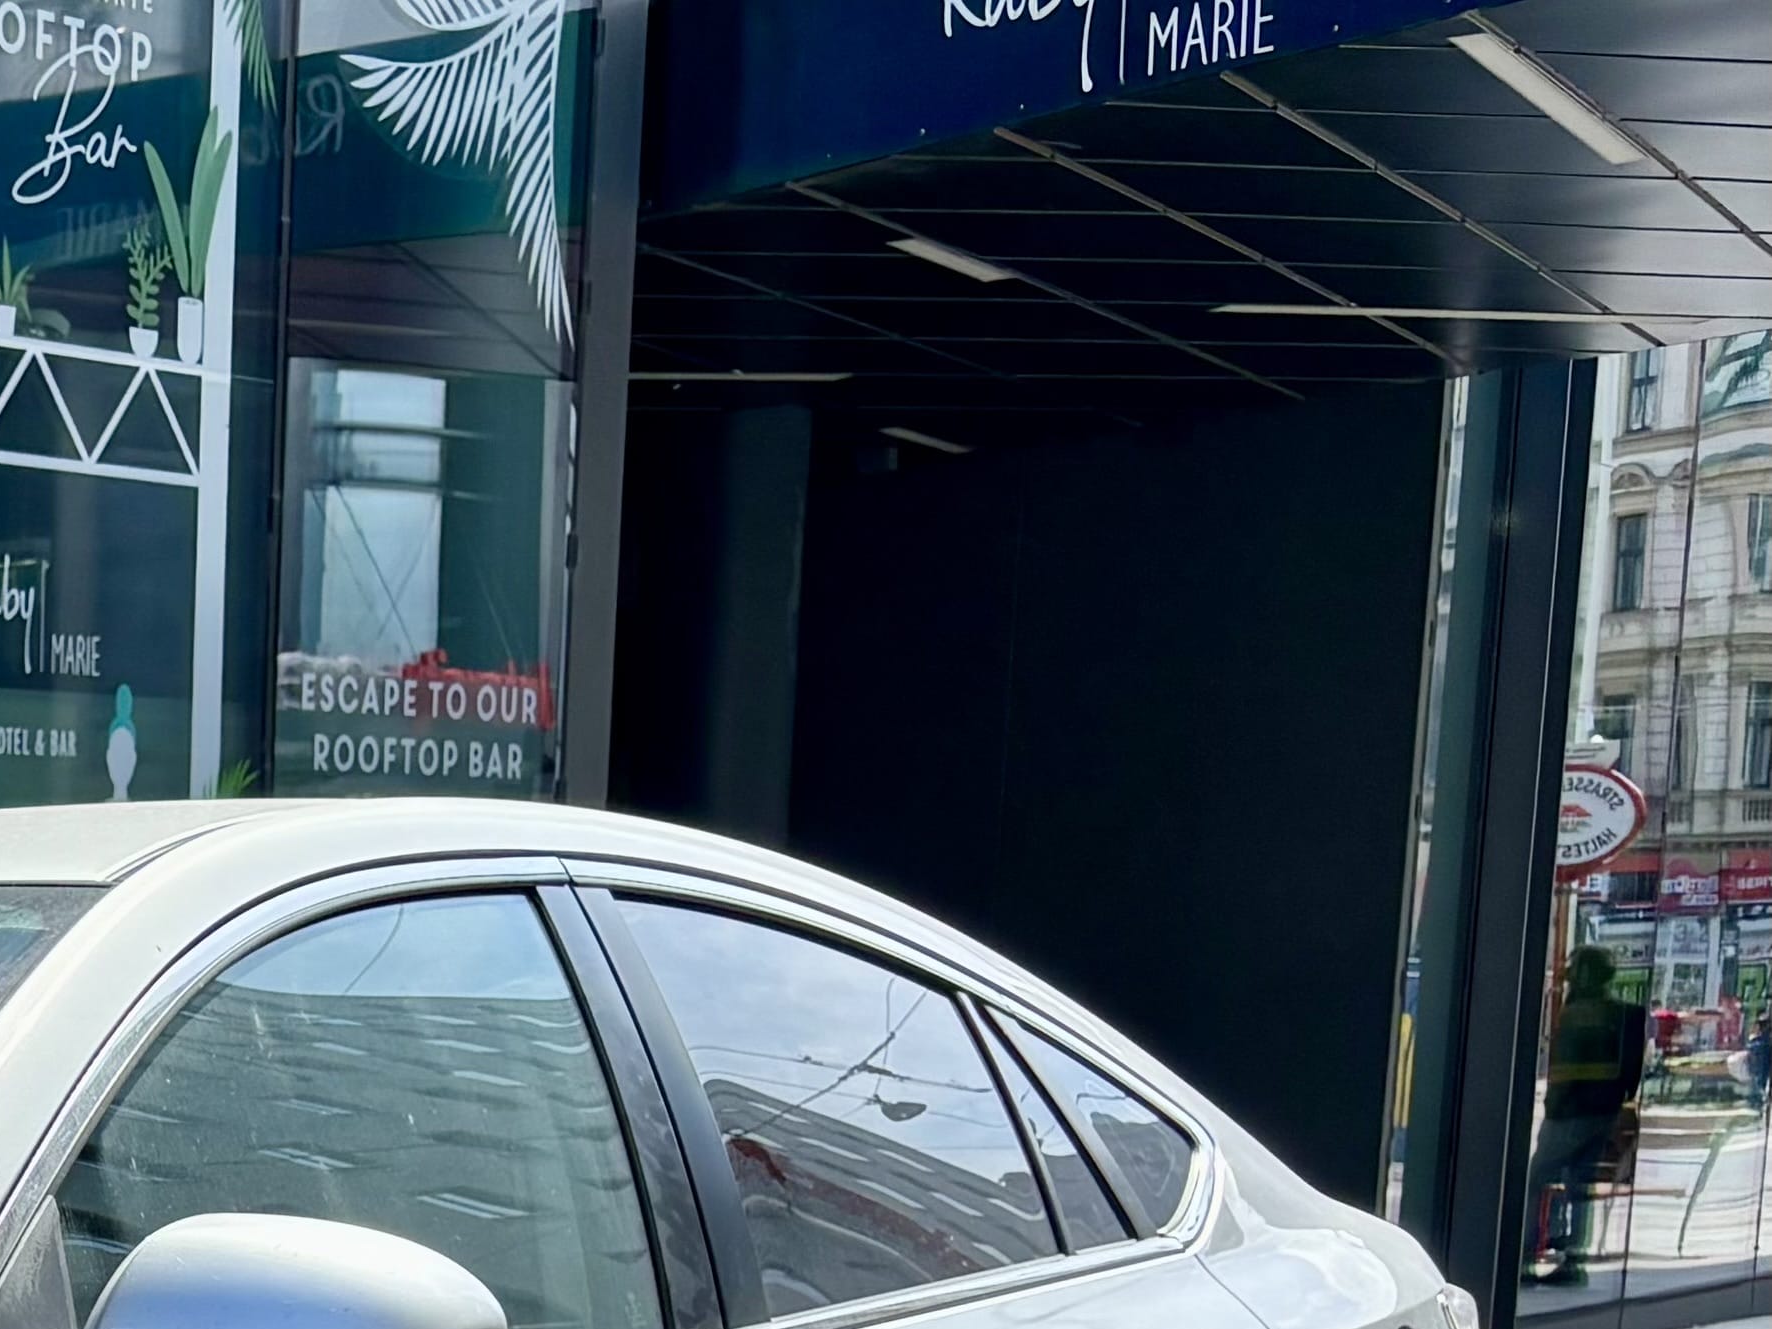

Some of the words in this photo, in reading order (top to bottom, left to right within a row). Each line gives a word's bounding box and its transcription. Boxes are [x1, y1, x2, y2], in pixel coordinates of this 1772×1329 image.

[1147, 0, 1274, 76] MARIE
[12, 44, 137, 204] Bar
[51, 633, 102, 678] MARIE
[301, 672, 418, 718] ESCAPE
[428, 681, 467, 720] TO
[476, 684, 537, 724] OUR
[34, 728, 46, 757] &
[50, 729, 77, 758] BAR
[313, 733, 459, 777] ROOFTOP
[468, 741, 523, 781] BAR
